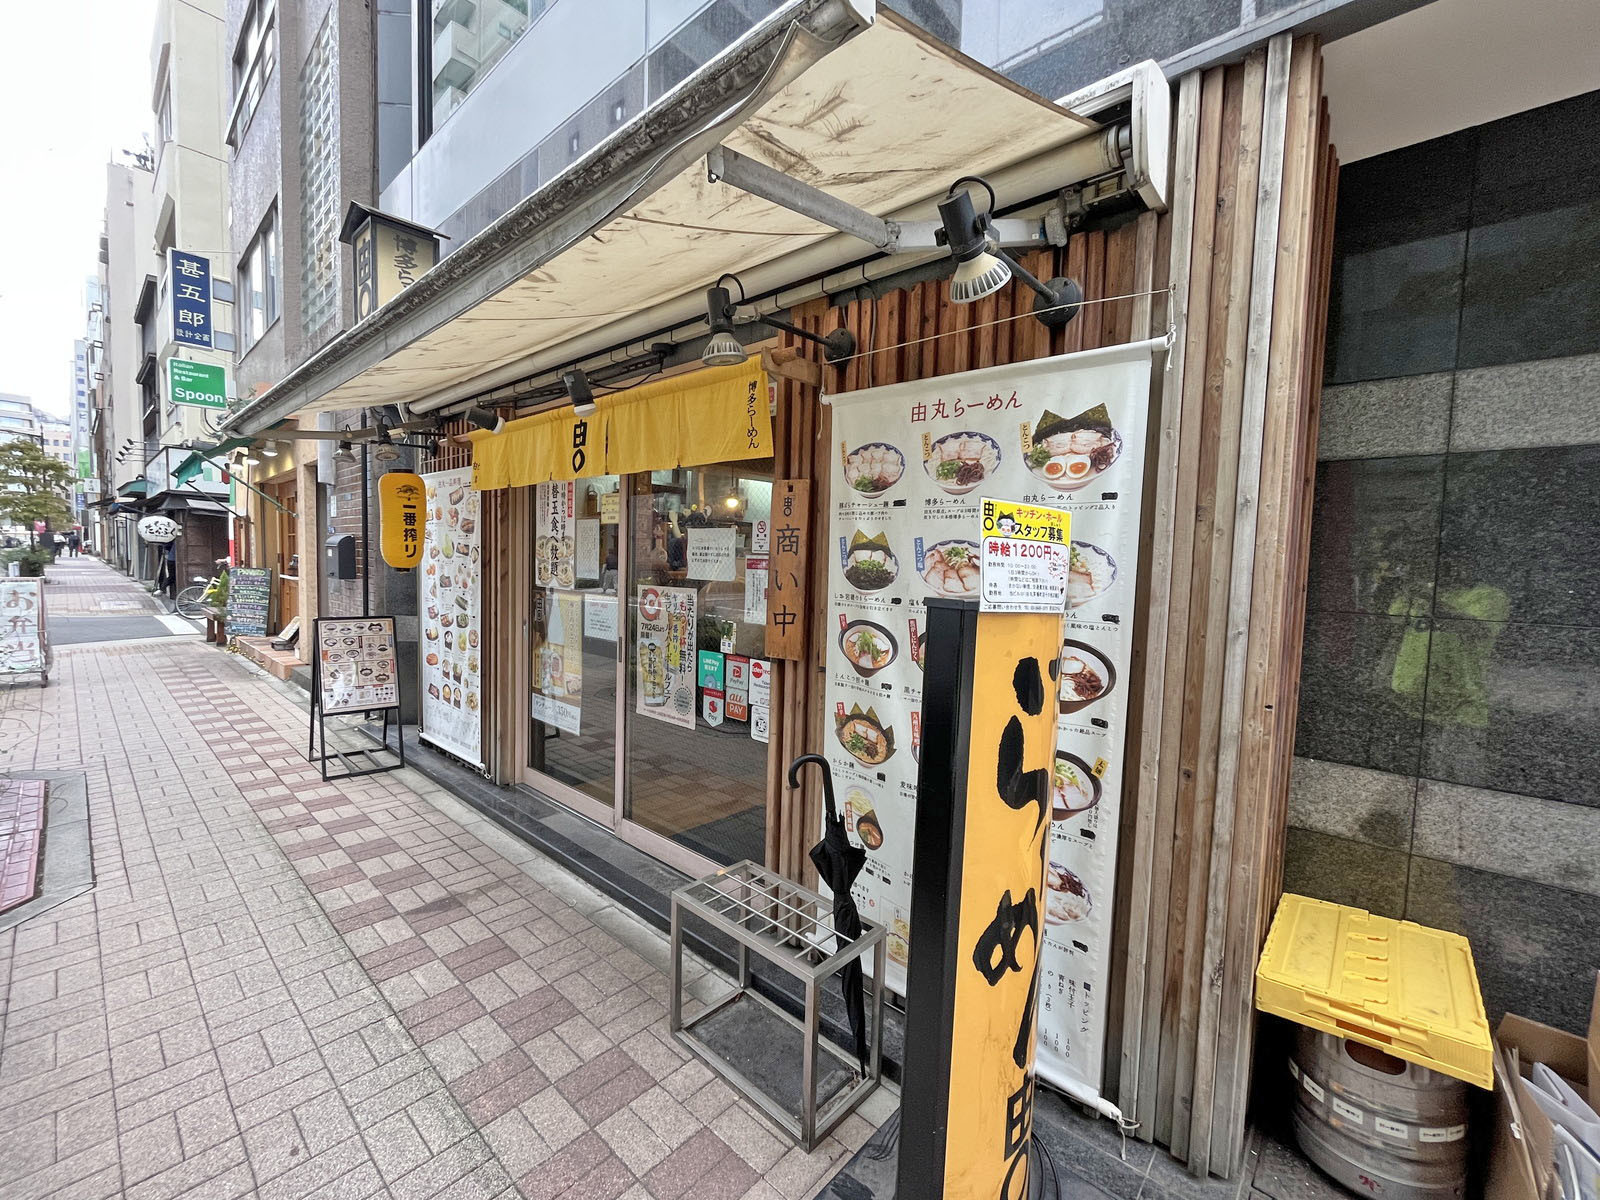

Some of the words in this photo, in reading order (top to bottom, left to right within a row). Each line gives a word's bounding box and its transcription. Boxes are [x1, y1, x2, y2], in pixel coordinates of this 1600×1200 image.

[176, 259, 207, 328] 甚五郎
[173, 368, 209, 379] Restaurant
[175, 387, 224, 404] Spoon
[911, 390, 1023, 424] 由丸らーめん
[747, 380, 760, 450] 博多らーめん
[1022, 423, 1031, 450] とんこつ
[925, 498, 966, 507] 博多らーめん
[1023, 494, 1074, 502] 由丸らーめん
[403, 504, 417, 558] 一番搾り
[550, 483, 560, 577] 替玉食べ放題
[1016, 508, 1063, 523] キッチン・ホール
[1015, 523, 1064, 542] スタッフ募集
[772, 524, 801, 638] 商い中
[6, 589, 37, 663] お弁当
[686, 593, 694, 673] 当たりが出たら
[729, 704, 743, 715] PAY
[1068, 979, 1077, 1009] 味付玉子
[1080, 992, 1090, 1033] トッピング
